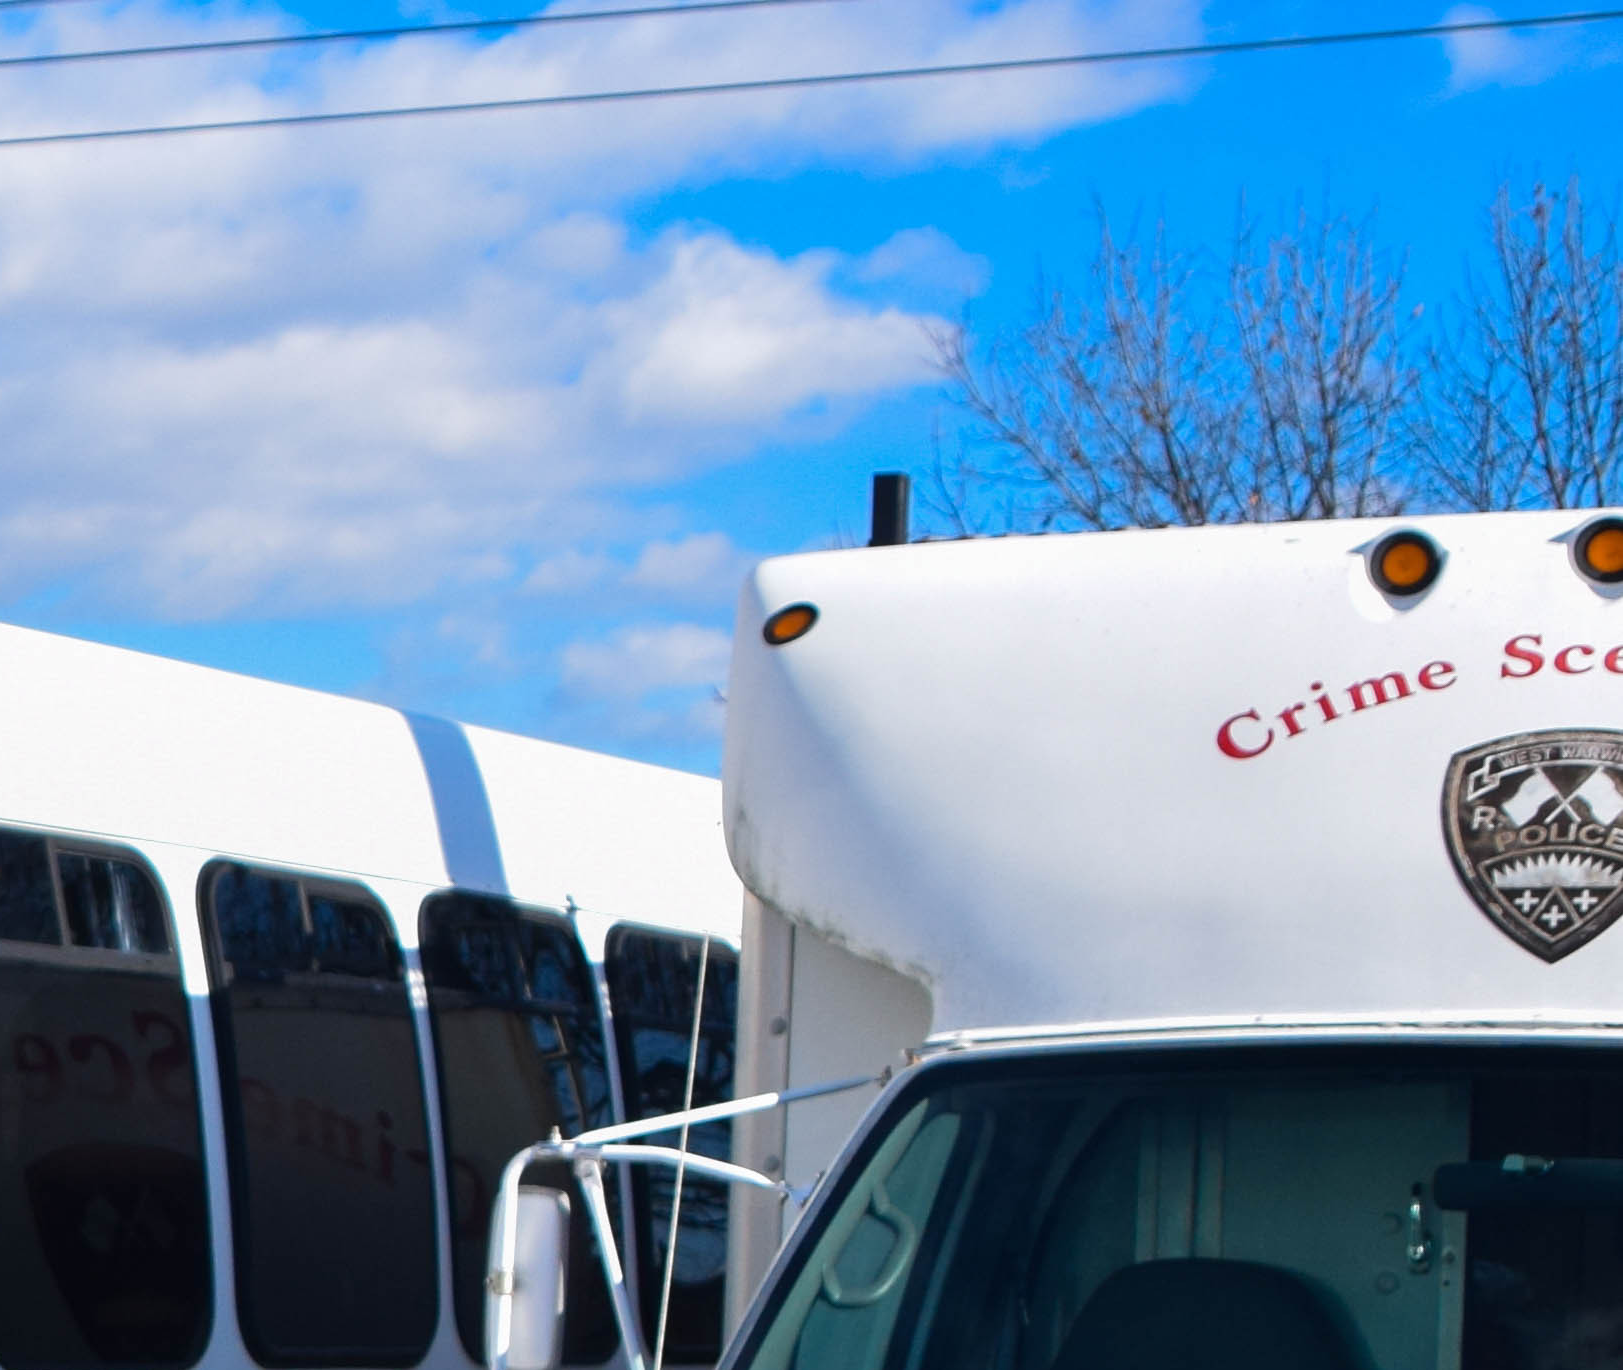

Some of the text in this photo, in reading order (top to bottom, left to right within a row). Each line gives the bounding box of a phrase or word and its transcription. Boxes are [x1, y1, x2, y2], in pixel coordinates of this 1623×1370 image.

[1216, 659, 1459, 760] Crime
[1500, 747, 1552, 768] WEST
[1495, 822, 1623, 851] POLICE
